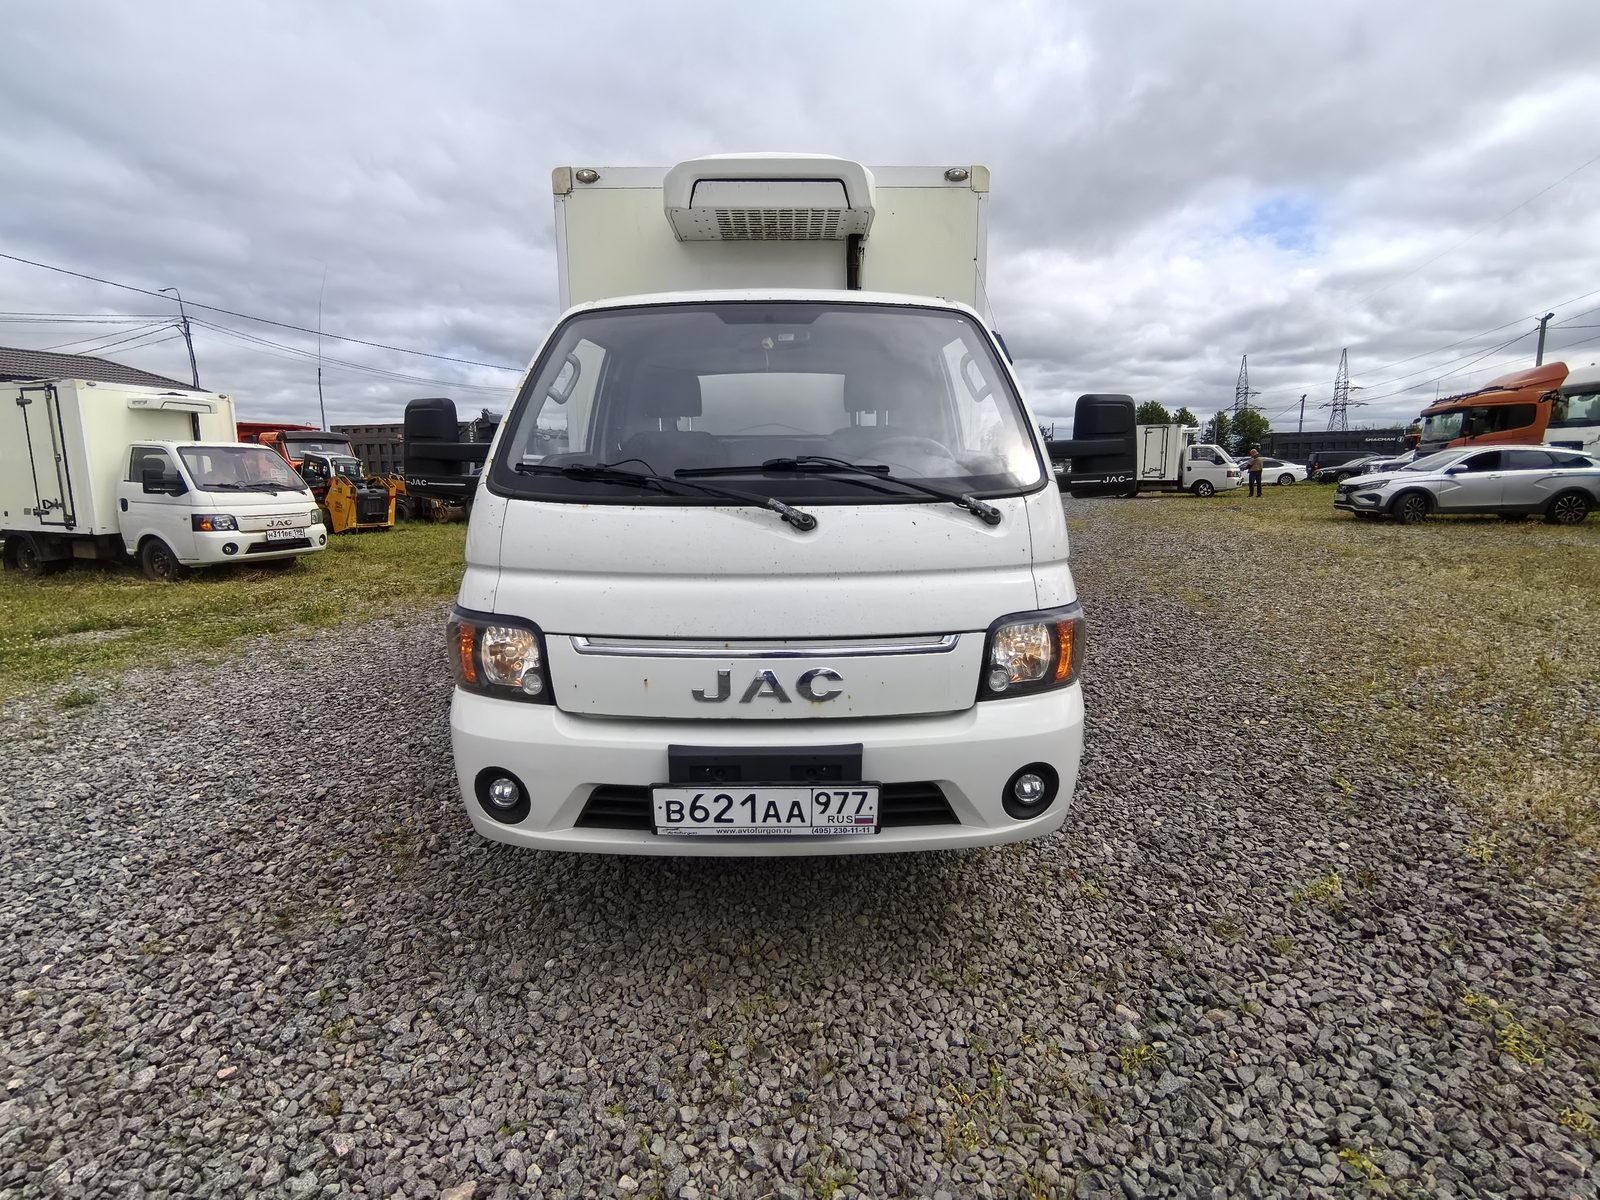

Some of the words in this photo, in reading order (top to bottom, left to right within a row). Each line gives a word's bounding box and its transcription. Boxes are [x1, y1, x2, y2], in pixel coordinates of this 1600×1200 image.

[410, 478, 427, 486] JAC
[1102, 475, 1125, 483] JAC
[266, 519, 292, 527] JAC
[691, 667, 844, 703] JAC
[814, 791, 869, 815] 977
[827, 815, 853, 824] RUS
[715, 828, 792, 836] www.avtofurgon.ru
[811, 826, 831, 835] (495)
[833, 826, 871, 835] 230-11-11
